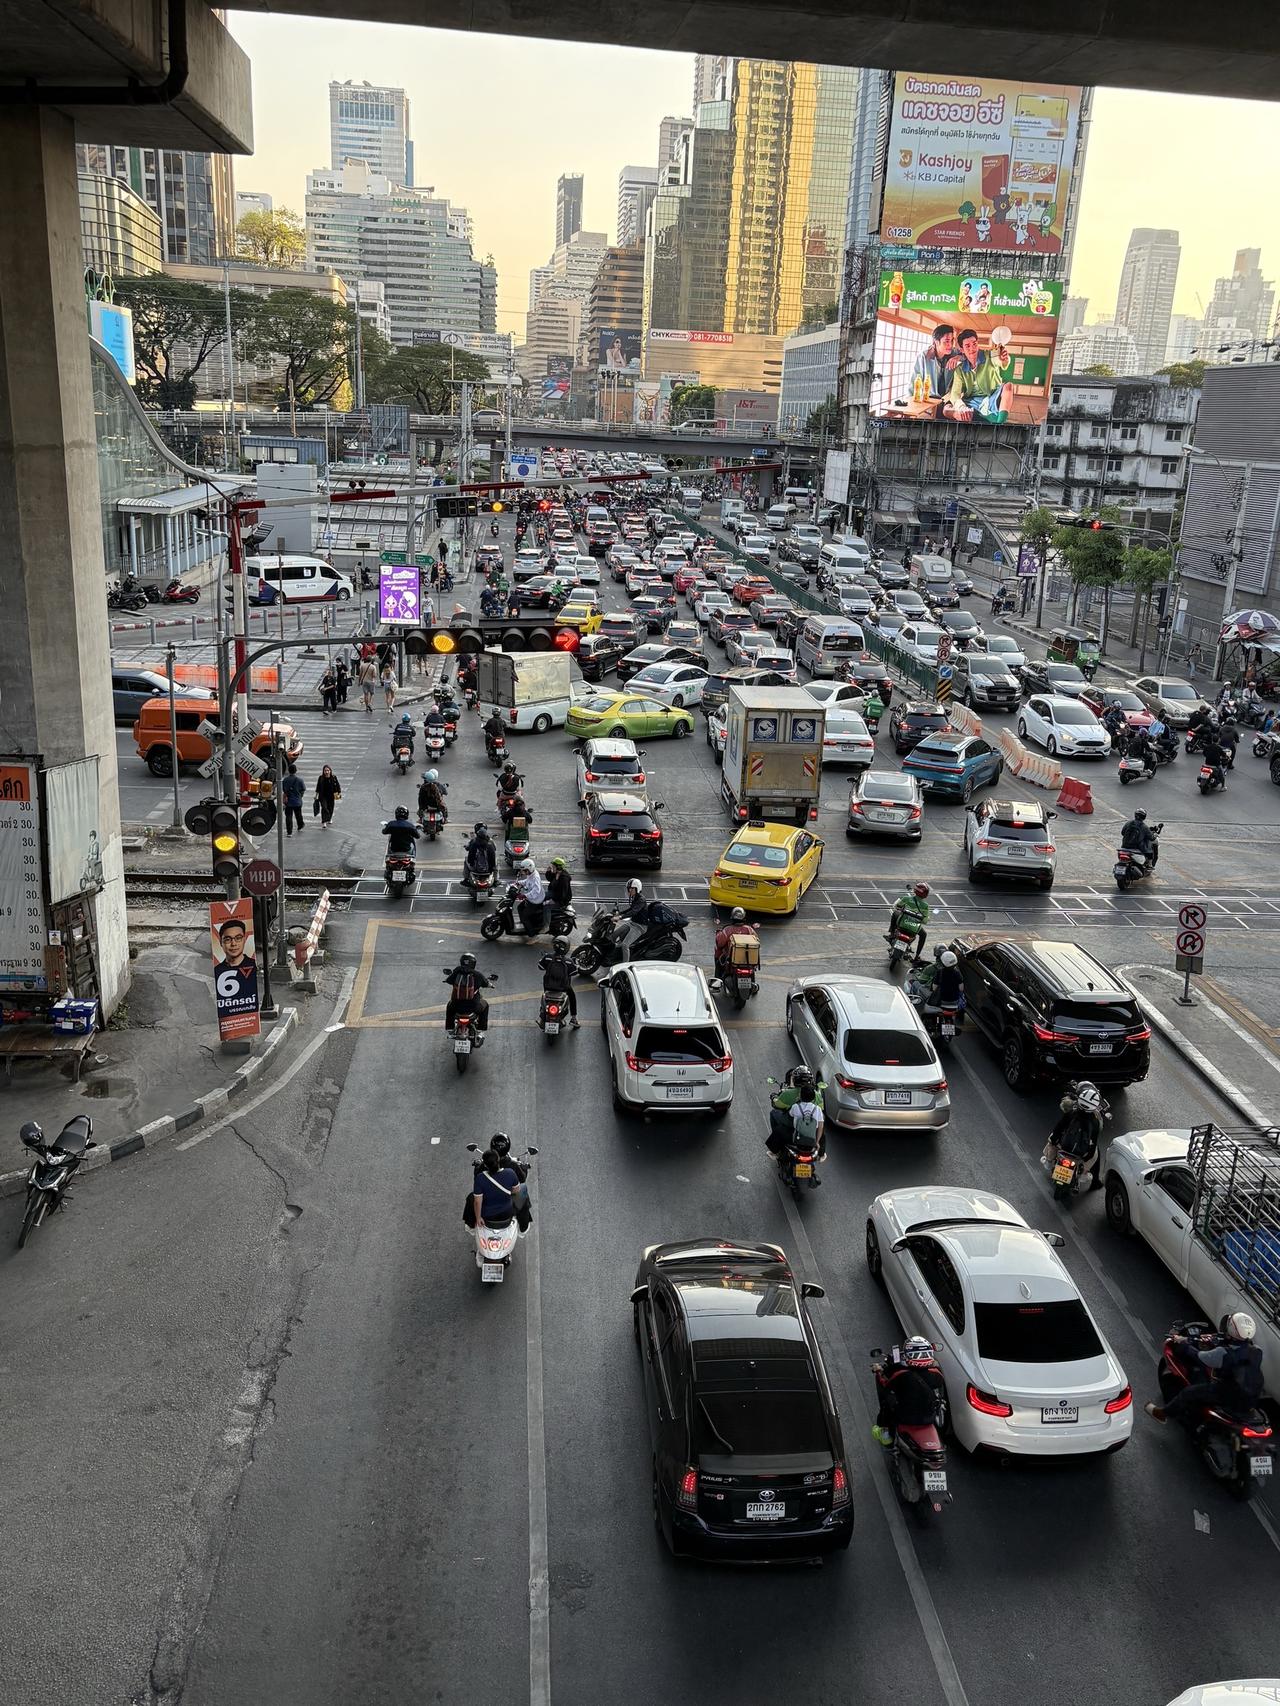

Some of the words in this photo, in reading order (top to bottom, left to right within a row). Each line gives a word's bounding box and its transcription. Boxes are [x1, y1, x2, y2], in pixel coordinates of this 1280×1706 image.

[905, 76, 981, 97] บัตรกดเงินสด
[902, 101, 975, 122] แคชจอย
[977, 95, 1005, 125] อีซี่
[918, 153, 973, 172] Kashjoy
[938, 174, 966, 184] Capital
[893, 228, 912, 237] 1258
[920, 250, 935, 259] Plan
[736, 399, 756, 409] J&T
[238, 728, 258, 745] รถไฟ
[240, 757, 260, 775] รถไฟ
[20, 802, 34, 811] 30.
[21, 820, 35, 829] 30.
[22, 837, 36, 847] 30.
[24, 855, 37, 865] 30.
[24, 873, 38, 882] 30.
[249, 870, 275, 888] หยุด
[26, 890, 40, 899] 30.
[27, 907, 41, 917] 30.
[29, 925, 42, 934] 30.
[30, 942, 41, 950] 30
[31, 958, 42, 968] 30
[217, 970, 240, 997] 6
[218, 994, 256, 1008] ปิติกรณ์
[748, 1503, 764, 1512] 2กก
[765, 1503, 784, 1512] 2762
